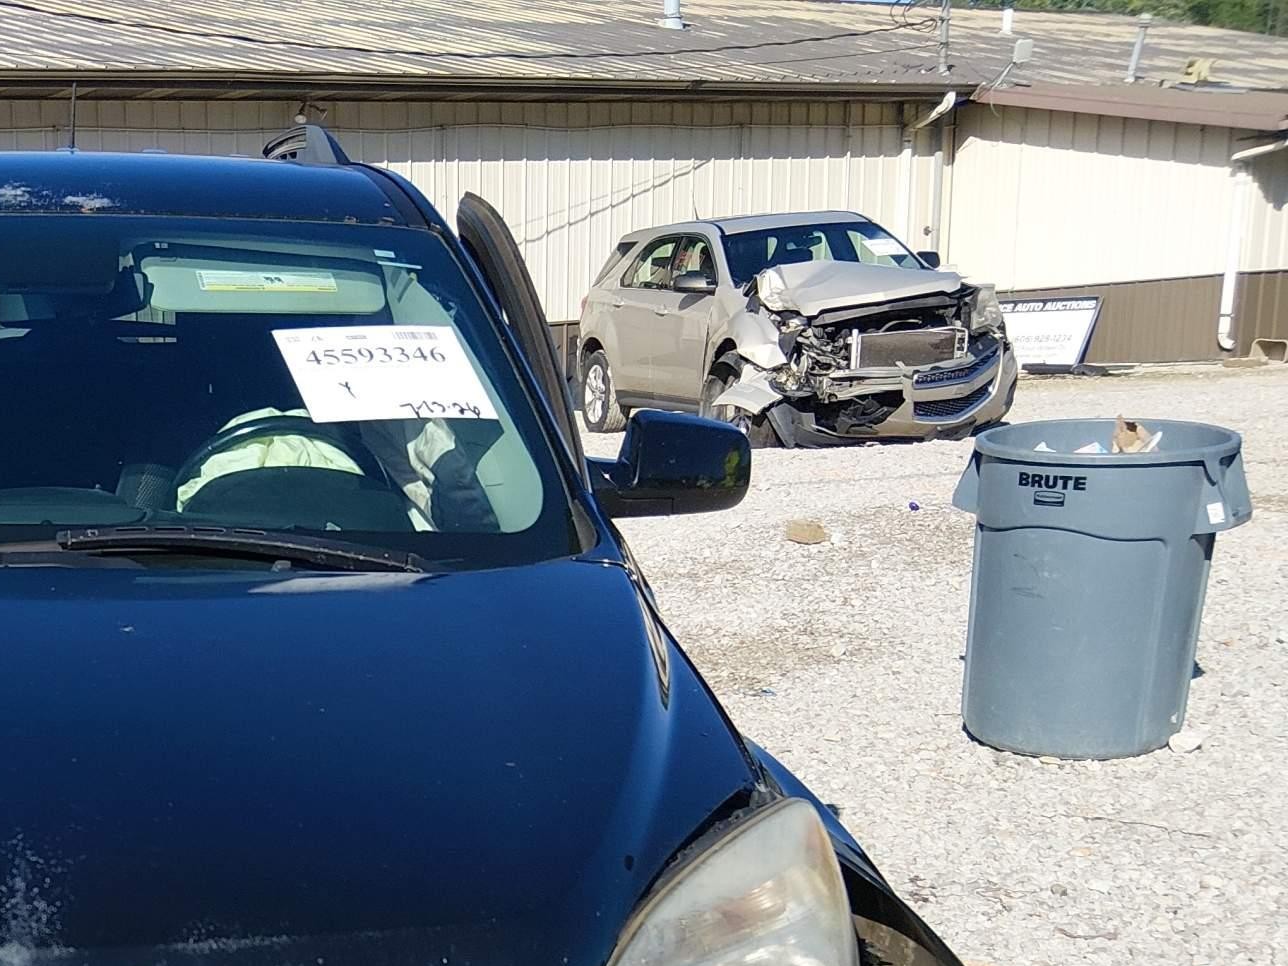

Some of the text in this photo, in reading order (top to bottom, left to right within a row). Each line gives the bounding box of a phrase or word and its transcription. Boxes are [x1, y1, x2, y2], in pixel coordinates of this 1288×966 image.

[1014, 303, 1044, 312] AUTO
[1043, 300, 1096, 311] AUCTIONS
[305, 346, 447, 366] 45593346
[1018, 472, 1087, 491] BRUTE
